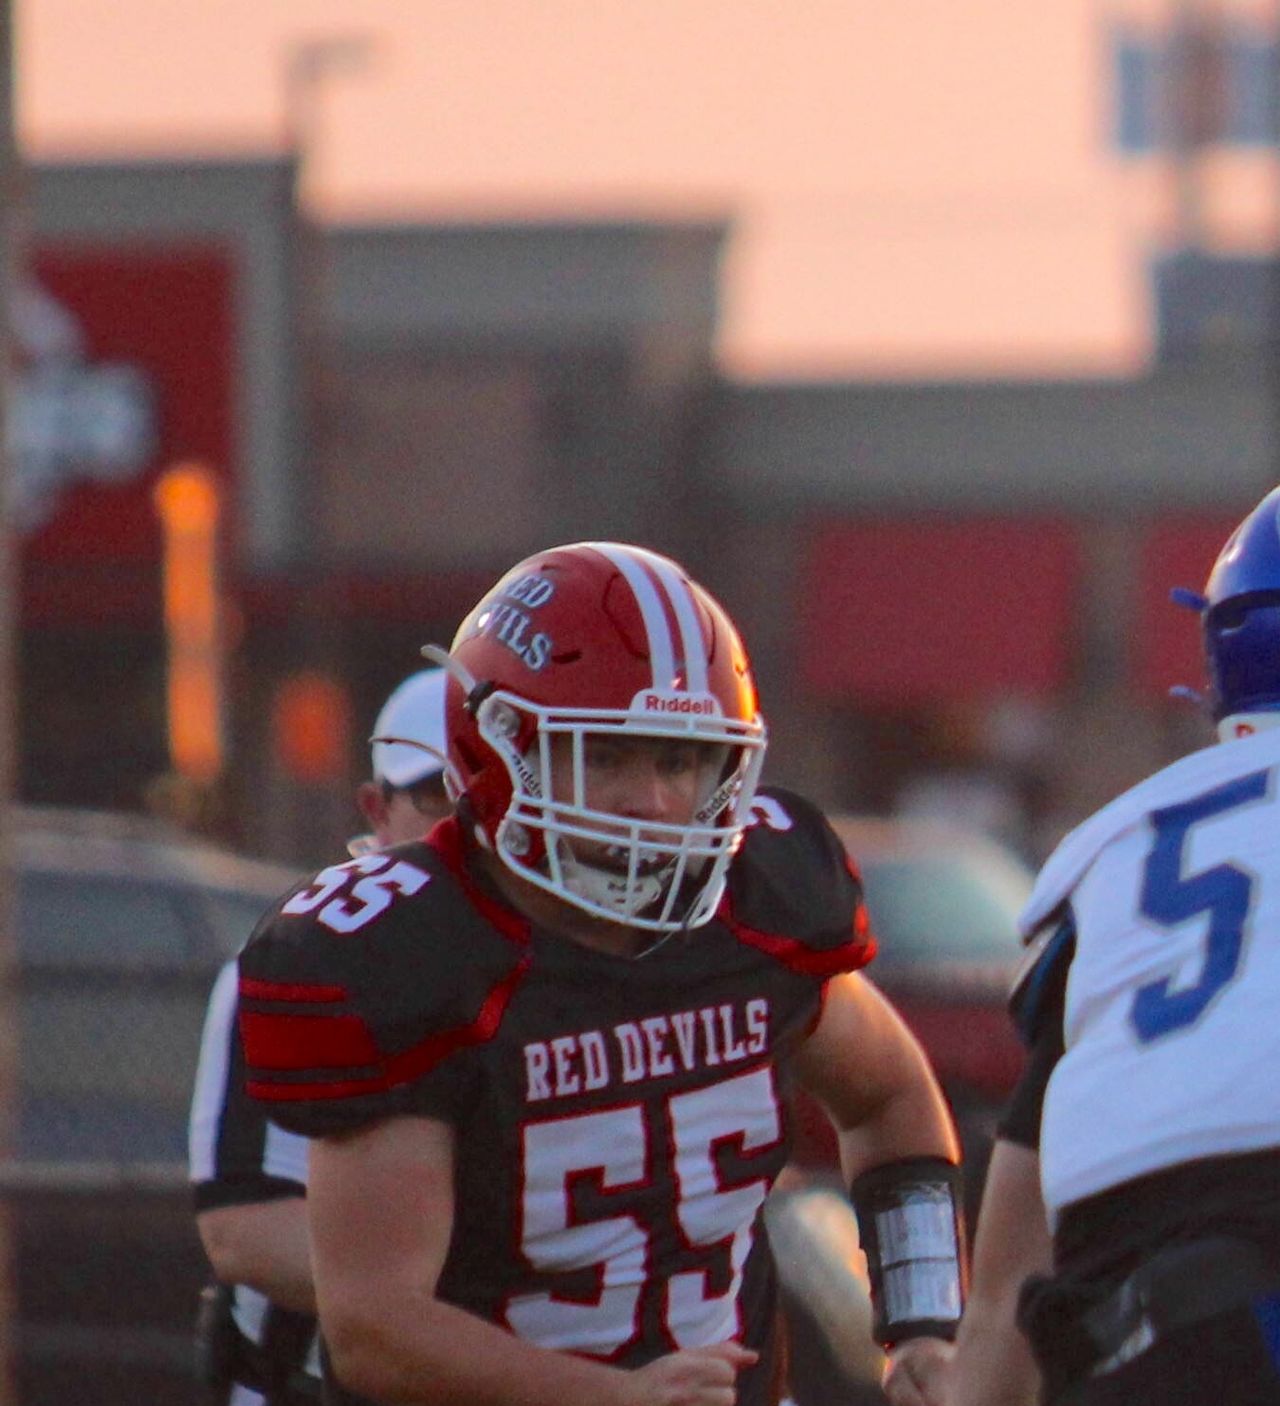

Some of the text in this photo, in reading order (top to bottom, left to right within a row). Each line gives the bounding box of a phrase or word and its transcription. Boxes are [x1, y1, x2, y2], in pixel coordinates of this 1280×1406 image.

[645, 695, 714, 714] Riddell
[281, 854, 433, 934] 55
[1130, 764, 1279, 1053] 5
[523, 998, 770, 1102] RED DEVILS
[503, 1064, 783, 1357] 55
